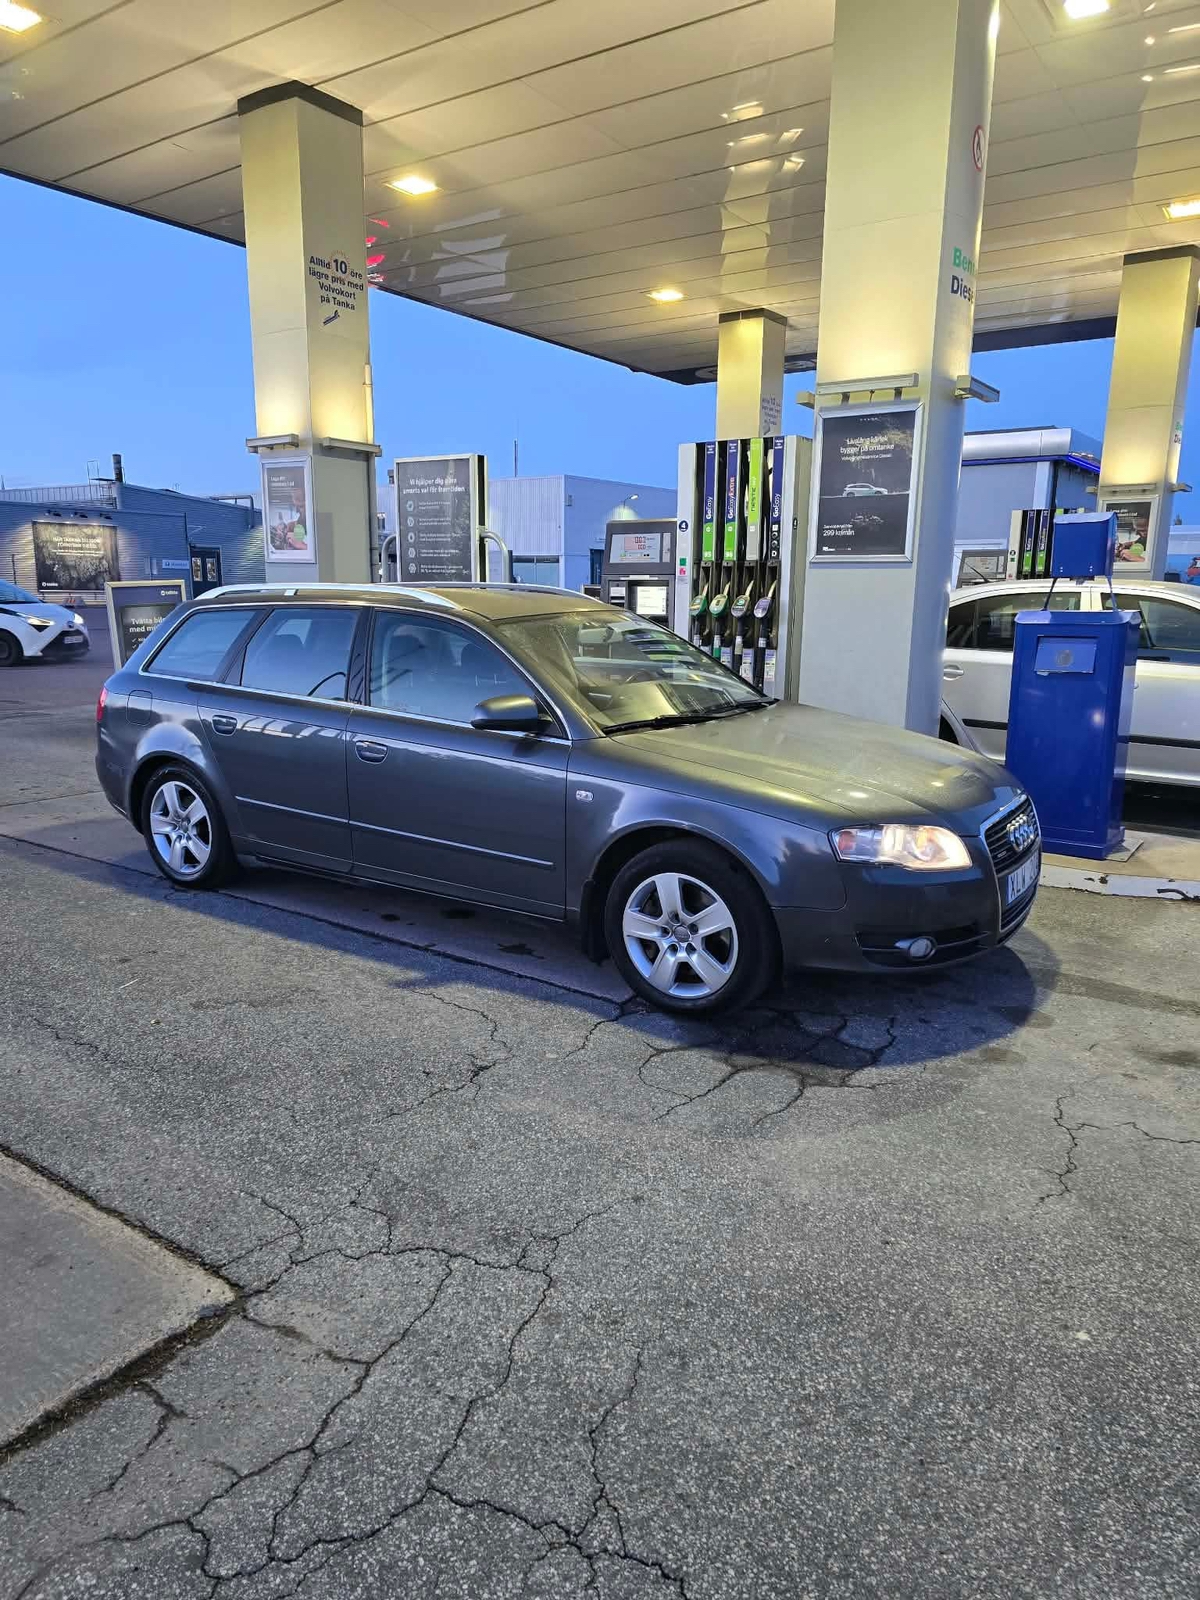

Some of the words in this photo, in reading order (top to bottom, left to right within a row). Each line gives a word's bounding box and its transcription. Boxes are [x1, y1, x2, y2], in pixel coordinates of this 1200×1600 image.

[309, 256, 331, 270] Alltid
[333, 259, 347, 274] 10
[350, 269, 363, 280] öre
[308, 267, 329, 280] lägre
[331, 275, 346, 287] pris
[347, 280, 364, 291] med
[318, 281, 356, 300] Volvokort
[320, 293, 331, 304] på
[332, 296, 355, 310] Tanka
[869, 443, 895, 452] omtanke
[705, 496, 713, 519] GoEasy
[773, 493, 781, 518] GoEasy
[130, 625, 145, 633] med
